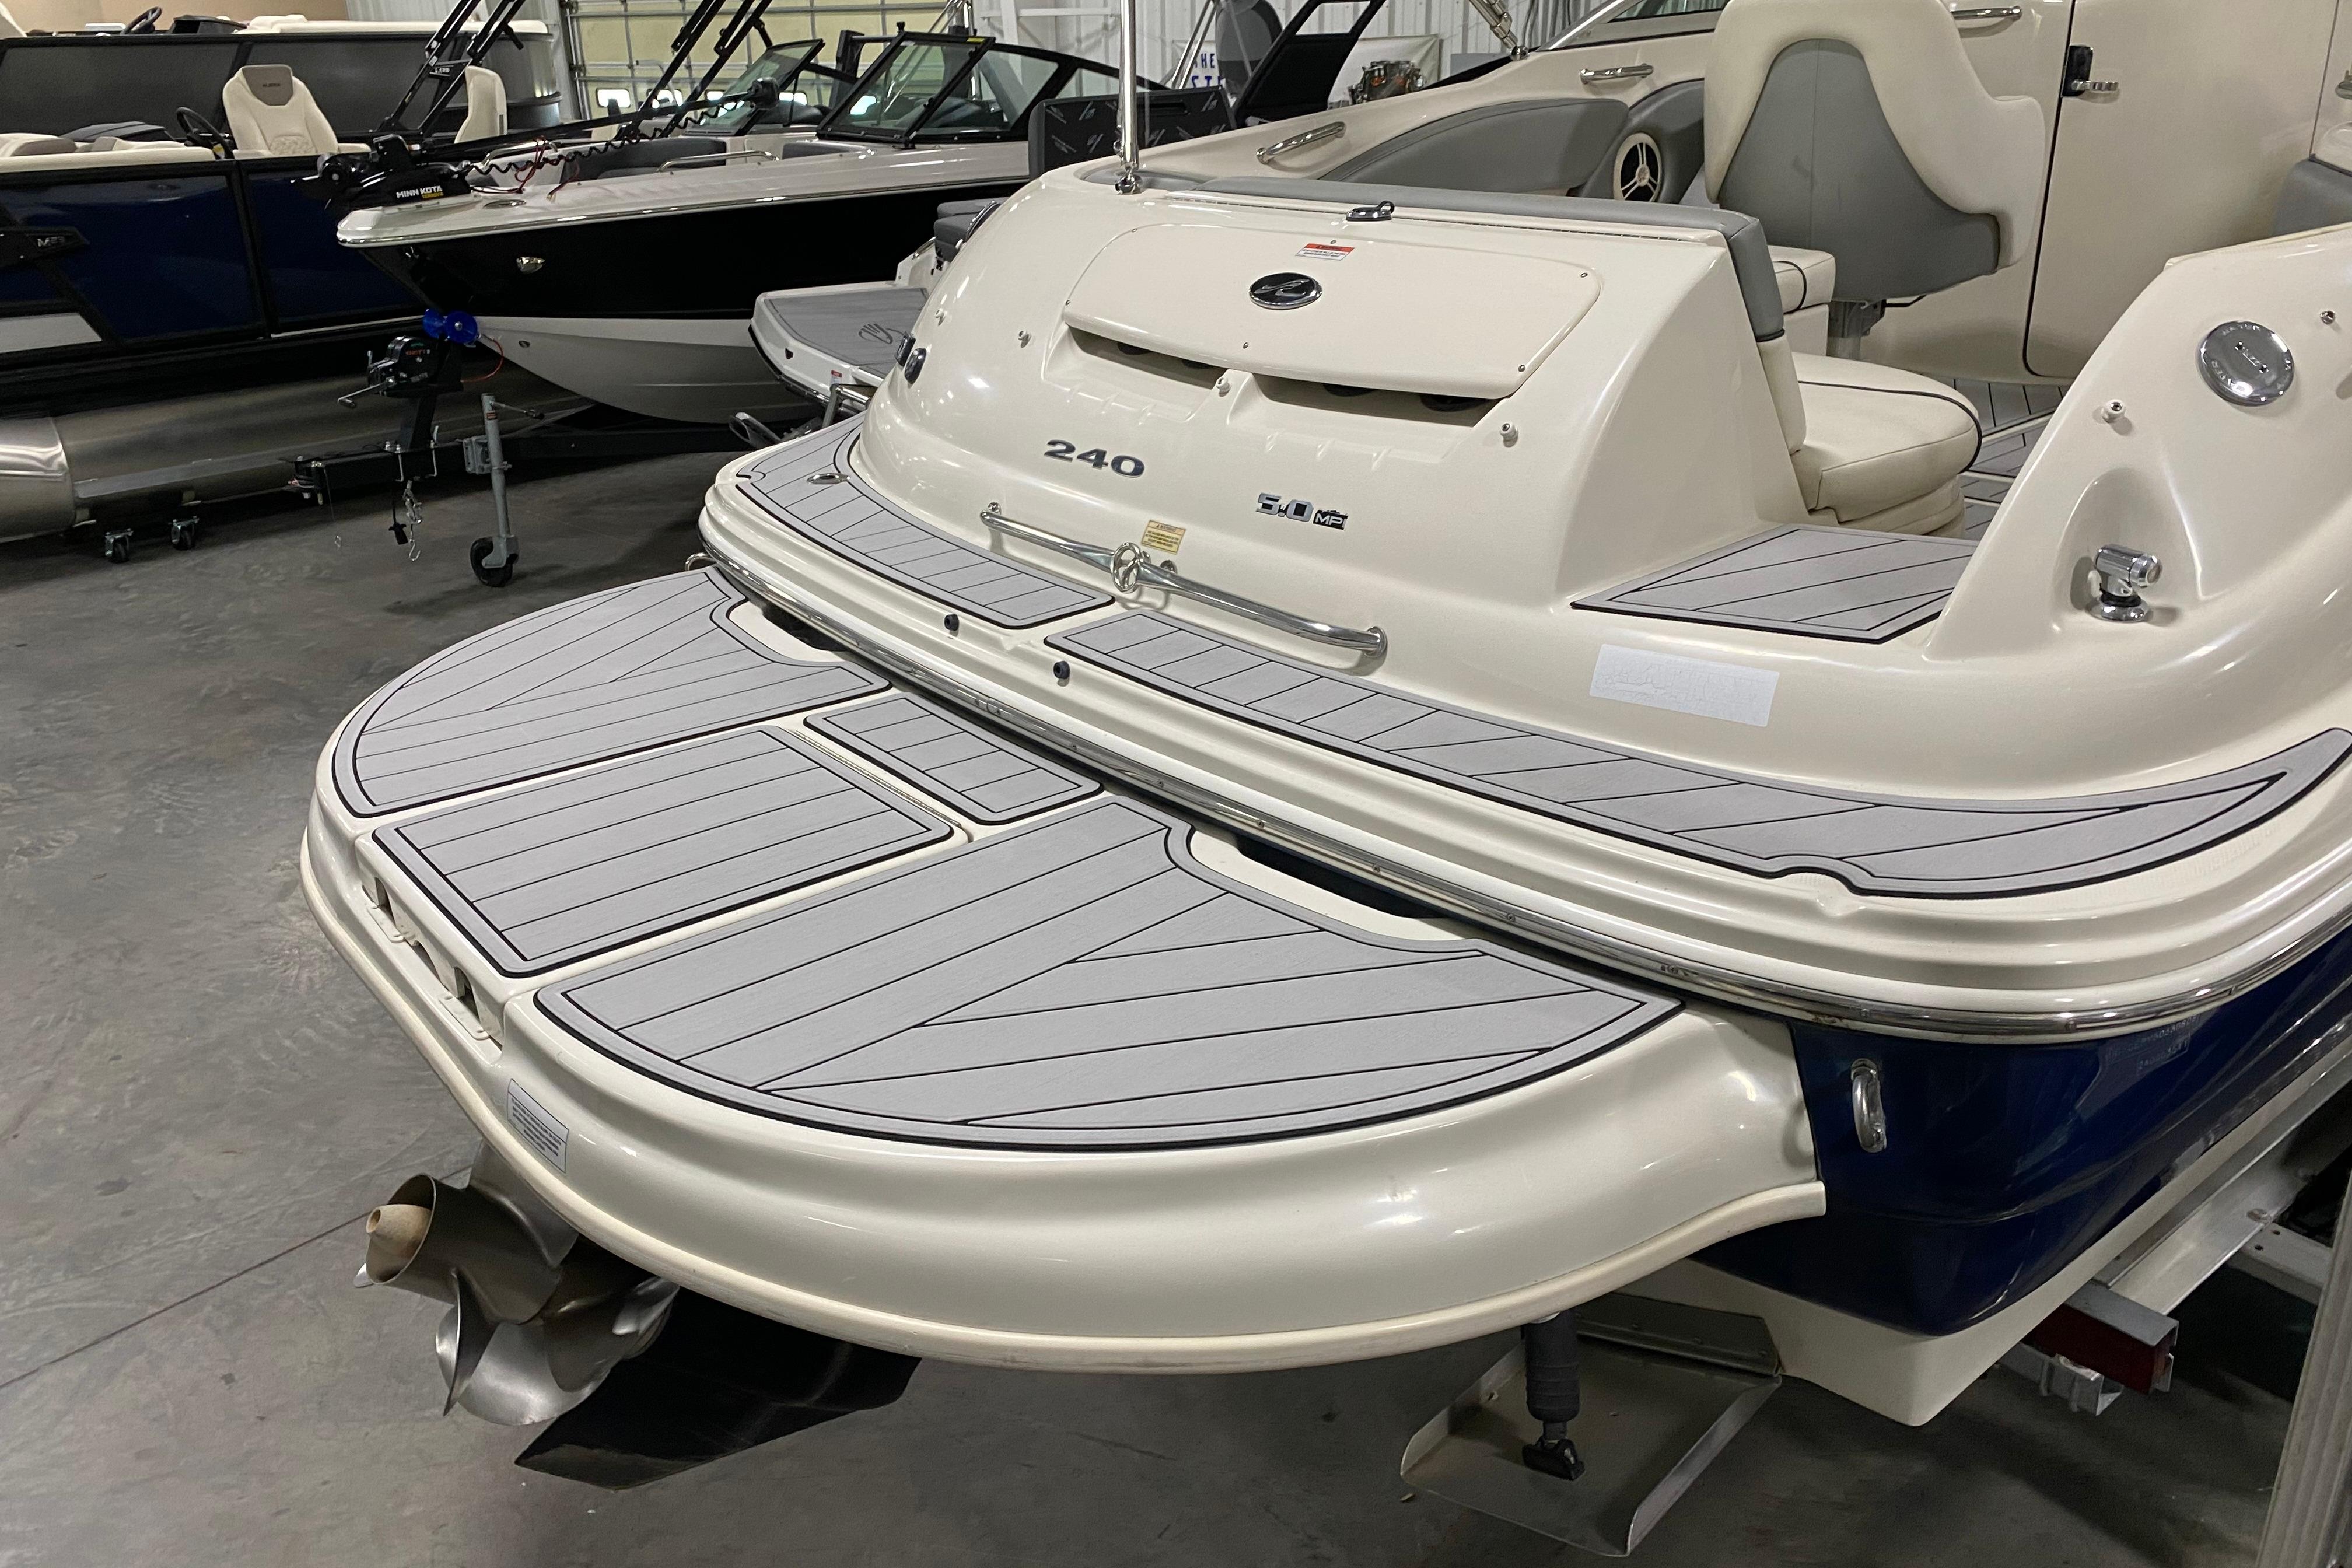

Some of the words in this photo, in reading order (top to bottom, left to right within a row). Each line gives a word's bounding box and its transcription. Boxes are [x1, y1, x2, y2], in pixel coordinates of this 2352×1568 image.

[396, 188, 419, 198] MINN
[420, 186, 443, 195] KOTA
[1044, 439, 1144, 478] 240
[1255, 492, 1314, 523] 5.0
